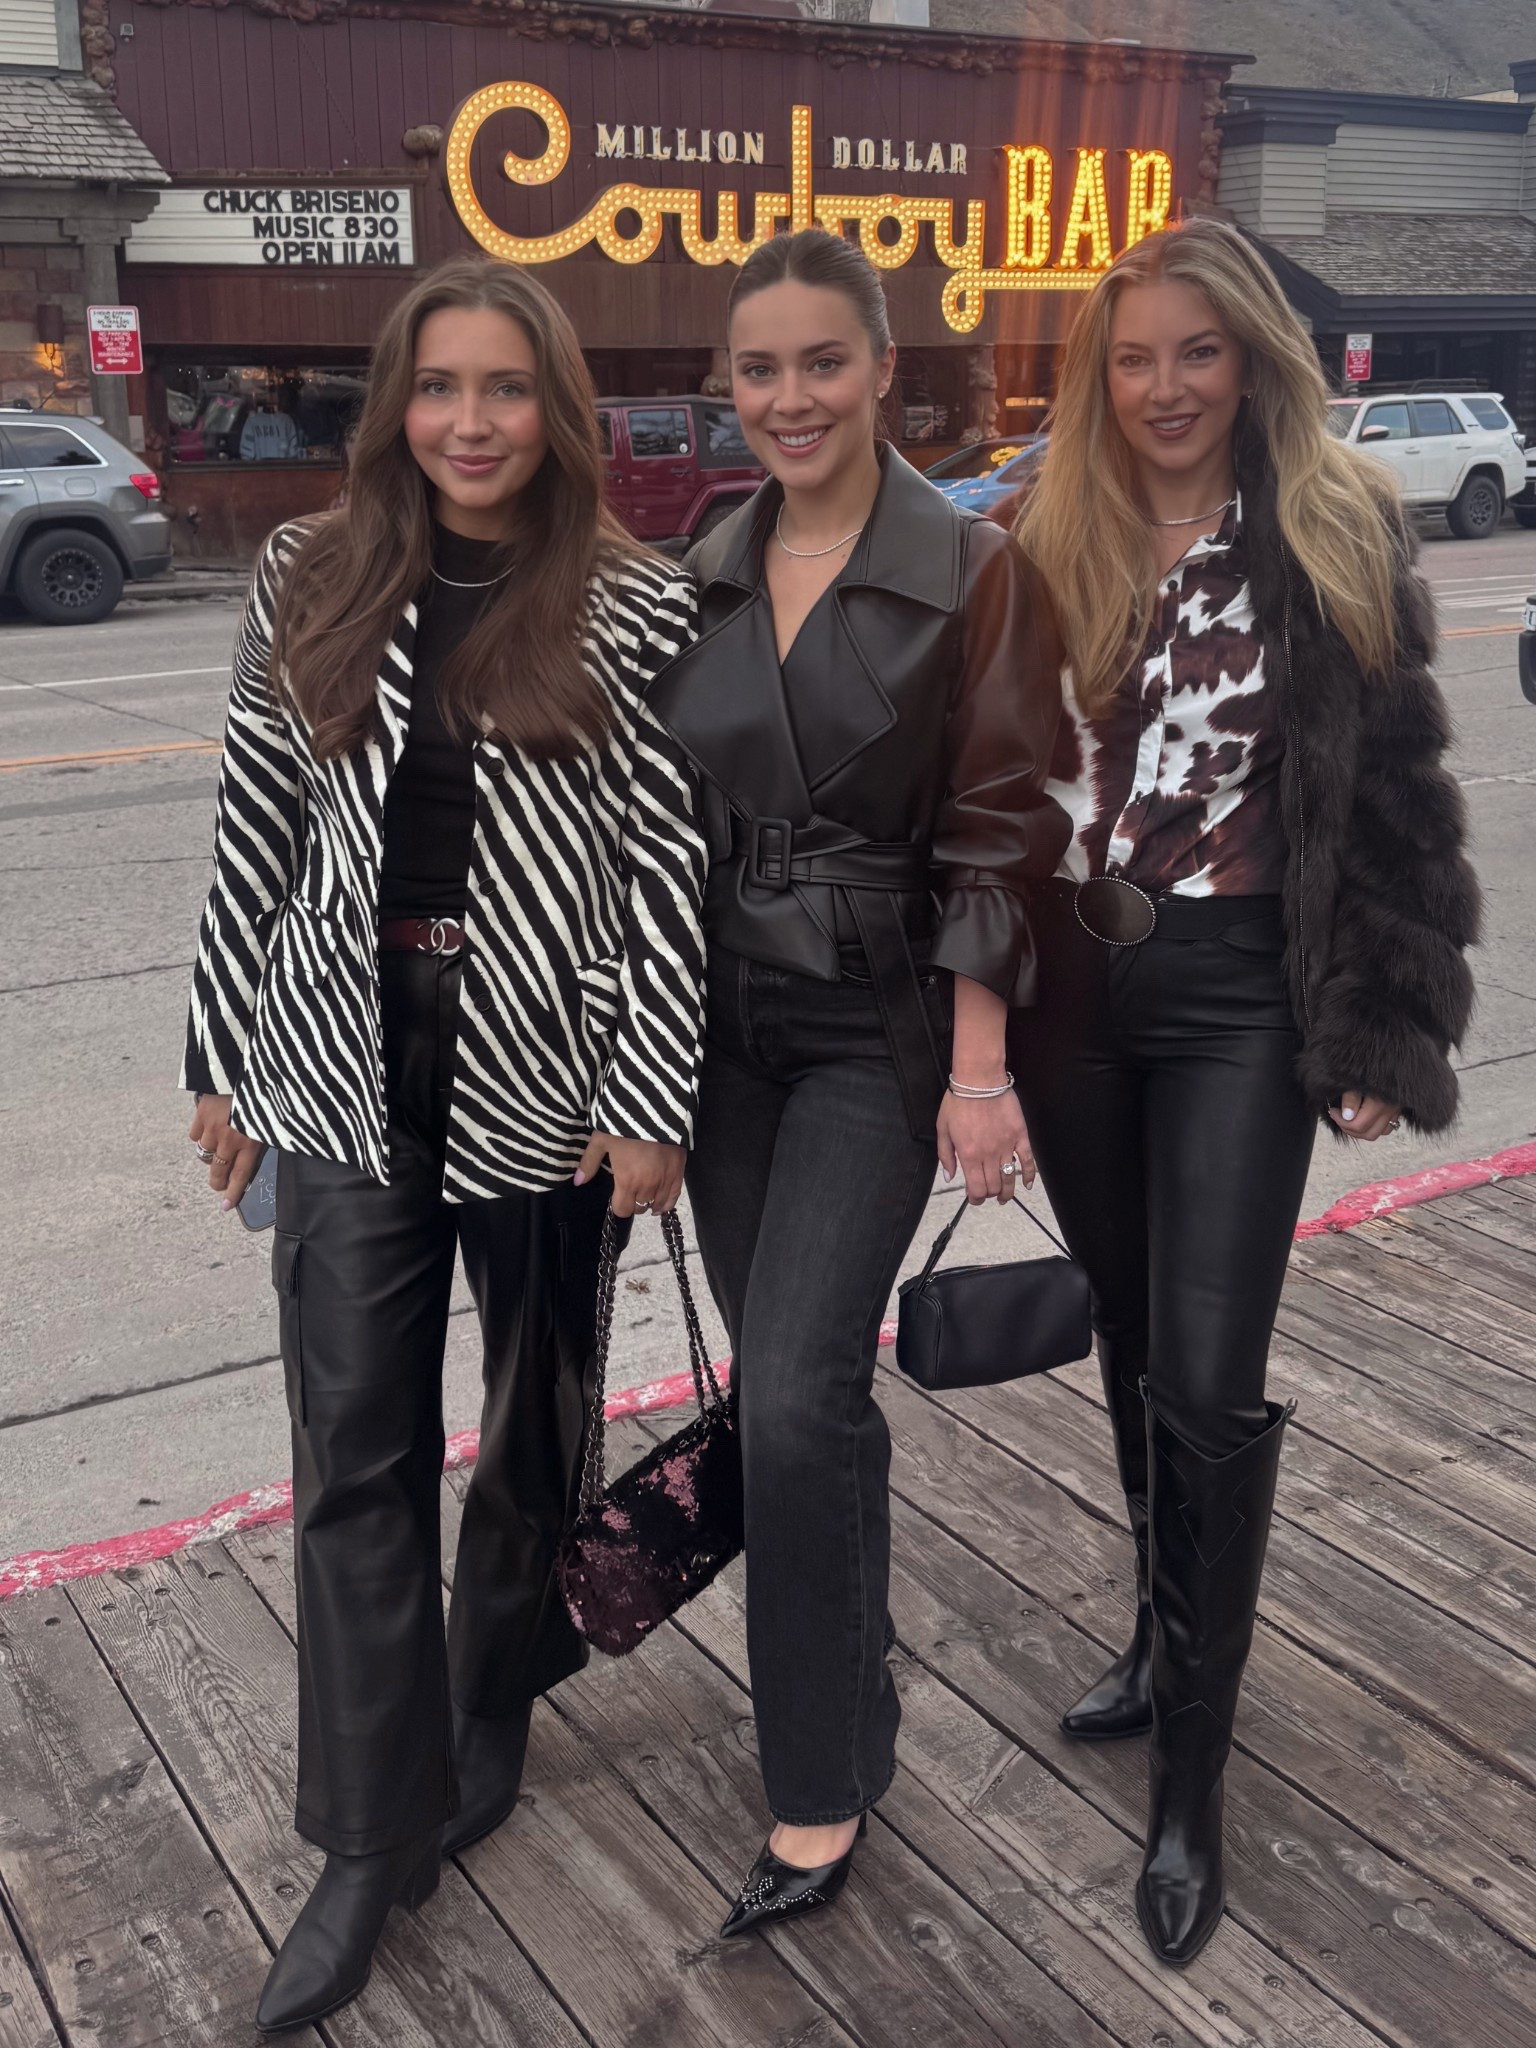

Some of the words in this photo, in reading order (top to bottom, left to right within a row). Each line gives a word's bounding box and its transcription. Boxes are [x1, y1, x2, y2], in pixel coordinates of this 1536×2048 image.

[595, 123, 764, 165] MILLION
[832, 136, 968, 175] DOLLAR
[203, 190, 283, 213] CHUCK
[291, 190, 399, 213] BRISENO
[1000, 144, 1172, 270] BAR
[253, 216, 334, 238] MUSIC
[345, 216, 398, 239] 830
[262, 241, 333, 264] OPEN
